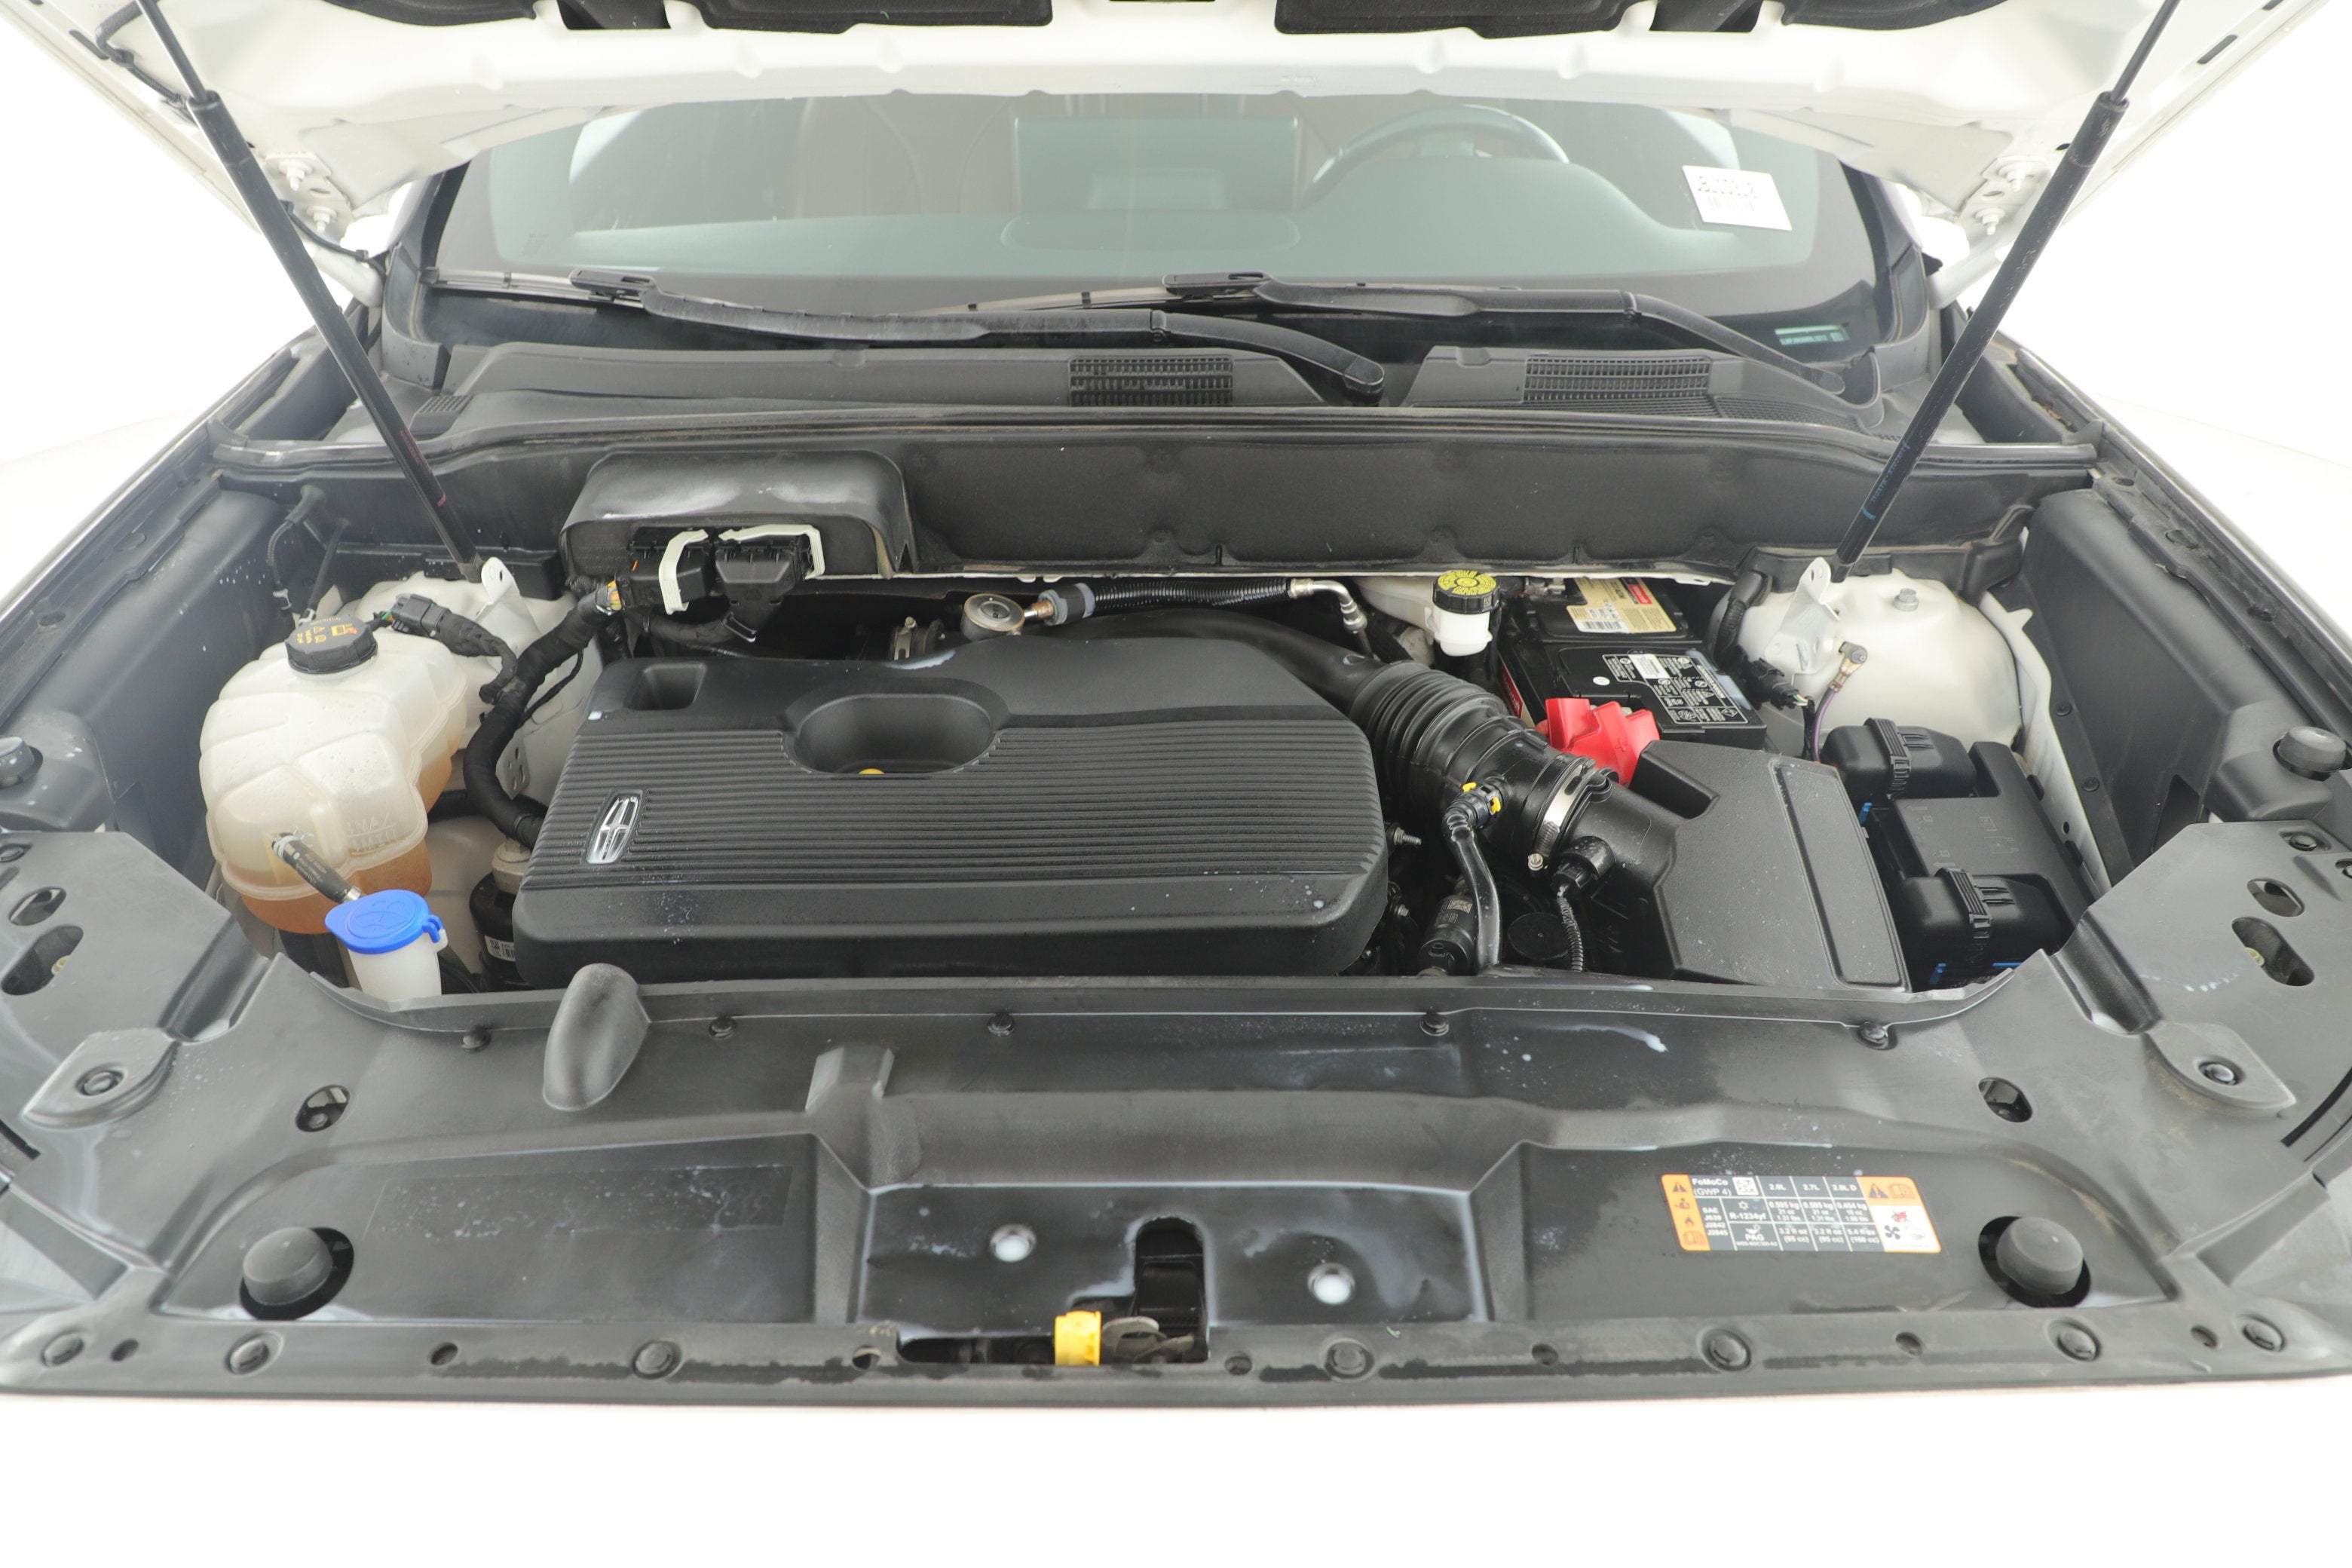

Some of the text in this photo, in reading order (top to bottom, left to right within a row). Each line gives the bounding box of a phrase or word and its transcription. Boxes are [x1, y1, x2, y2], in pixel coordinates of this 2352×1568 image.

[1694, 1188, 1733, 1197] (GWP 4)
[1789, 1202, 1800, 1210] kg
[1823, 1202, 1834, 1211] kg
[1857, 1202, 1868, 1211] kg
[1729, 1212, 1766, 1221] R-1234yf
